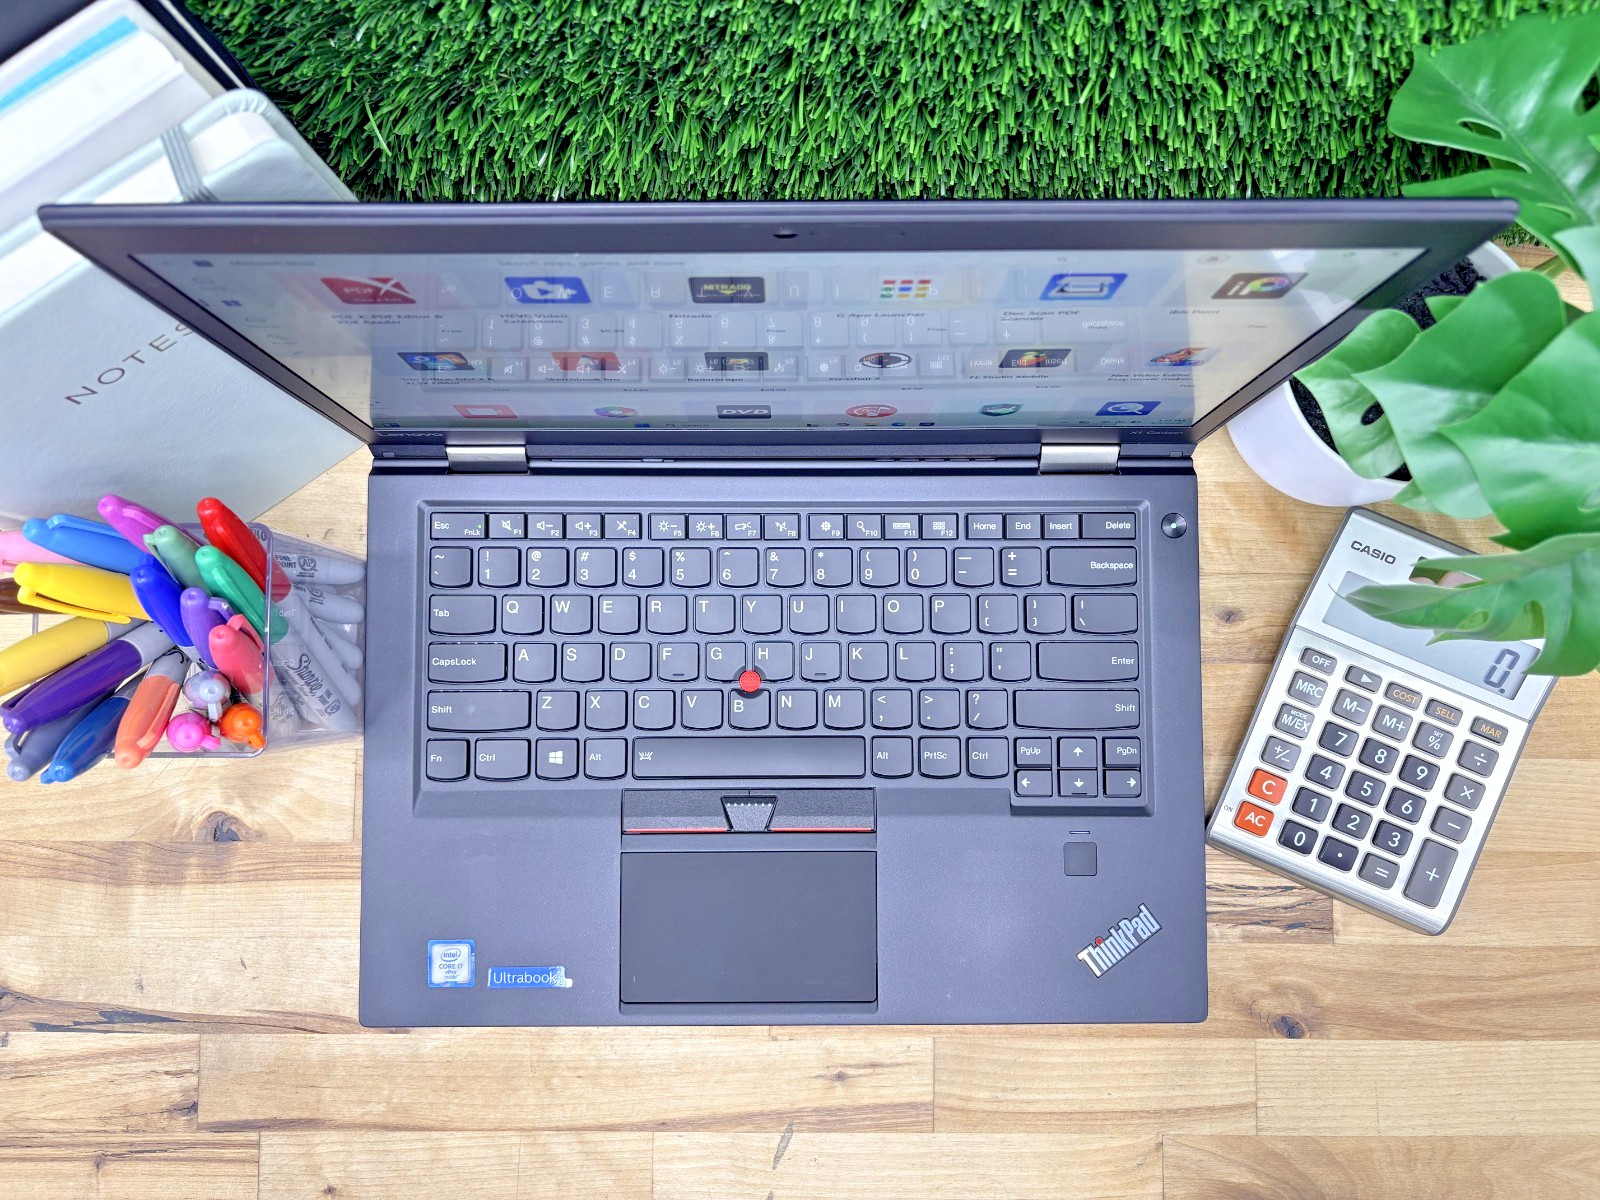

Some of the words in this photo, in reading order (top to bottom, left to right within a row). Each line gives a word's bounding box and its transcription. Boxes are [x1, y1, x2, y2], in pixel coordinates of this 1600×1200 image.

[434, 522, 450, 530] Esc
[973, 522, 996, 530] Home
[1015, 522, 1031, 530] End
[1049, 522, 1073, 530] Insert
[1105, 521, 1131, 530] Delete
[1350, 540, 1396, 565] CASIO
[1090, 562, 1134, 570] Backspace
[484, 569, 491, 580] 1
[531, 569, 541, 580] 2
[580, 569, 589, 580] 3
[628, 569, 637, 580] 4
[676, 569, 685, 580] 5
[722, 569, 732, 580] 6
[769, 569, 779, 580] 7
[816, 568, 826, 580] 8
[864, 568, 873, 580] 9
[910, 568, 920, 580] 0
[506, 600, 519, 614] Q
[554, 600, 571, 613] W
[603, 600, 613, 613] E
[651, 600, 662, 613] R
[699, 600, 709, 613] T
[746, 600, 757, 613] Y
[793, 600, 804, 613] U
[840, 600, 844, 613] I
[887, 600, 900, 613] O
[934, 600, 945, 612] P
[433, 609, 450, 617] Tab
[518, 649, 529, 661] A
[566, 648, 577, 662] S
[614, 648, 626, 661] D
[662, 648, 673, 660] F
[710, 648, 723, 660] G
[758, 648, 769, 660] H
[805, 648, 813, 660] J
[852, 648, 863, 660] K
[900, 648, 909, 660] L
[432, 658, 477, 667] CapsLock
[1111, 656, 1135, 665] Enter
[1312, 655, 1332, 668] OFF
[1295, 679, 1324, 698] MRC
[541, 696, 552, 709] Z
[590, 696, 601, 708] X
[638, 696, 650, 709] C
[686, 695, 697, 708] V
[781, 695, 792, 708] N
[828, 695, 841, 708] M
[1392, 689, 1418, 704] COST
[431, 706, 452, 714] Shift
[733, 700, 744, 713] B
[1114, 704, 1136, 713] Shift
[1290, 709, 1309, 720] MODE
[1435, 706, 1456, 722] SELL
[1281, 713, 1311, 733] M/EX
[1382, 714, 1406, 732] M+
[1433, 730, 1444, 739] SET
[1480, 723, 1502, 739] MAR
[1334, 731, 1348, 747] 7
[589, 753, 602, 761] Alt
[876, 751, 889, 760] Alt
[924, 751, 948, 760] PrtSc
[972, 751, 988, 760] Ctrl
[1020, 747, 1041, 756] PgUp
[1116, 747, 1137, 756] PgDn
[1374, 748, 1388, 764] 8
[430, 754, 442, 762] Fn
[479, 754, 496, 762] Ctrl
[1319, 765, 1333, 780] 4
[1416, 765, 1429, 781] 9
[1262, 780, 1277, 795] C
[1360, 780, 1374, 797] 5
[1223, 805, 1234, 813] ON
[1310, 798, 1318, 813] 1
[1401, 799, 1414, 815] 6
[1244, 811, 1266, 827] AC
[1346, 814, 1361, 831] 2
[1293, 831, 1306, 847] 0
[1387, 832, 1400, 847] 3
[1076, 902, 1162, 978] ThinkPad
